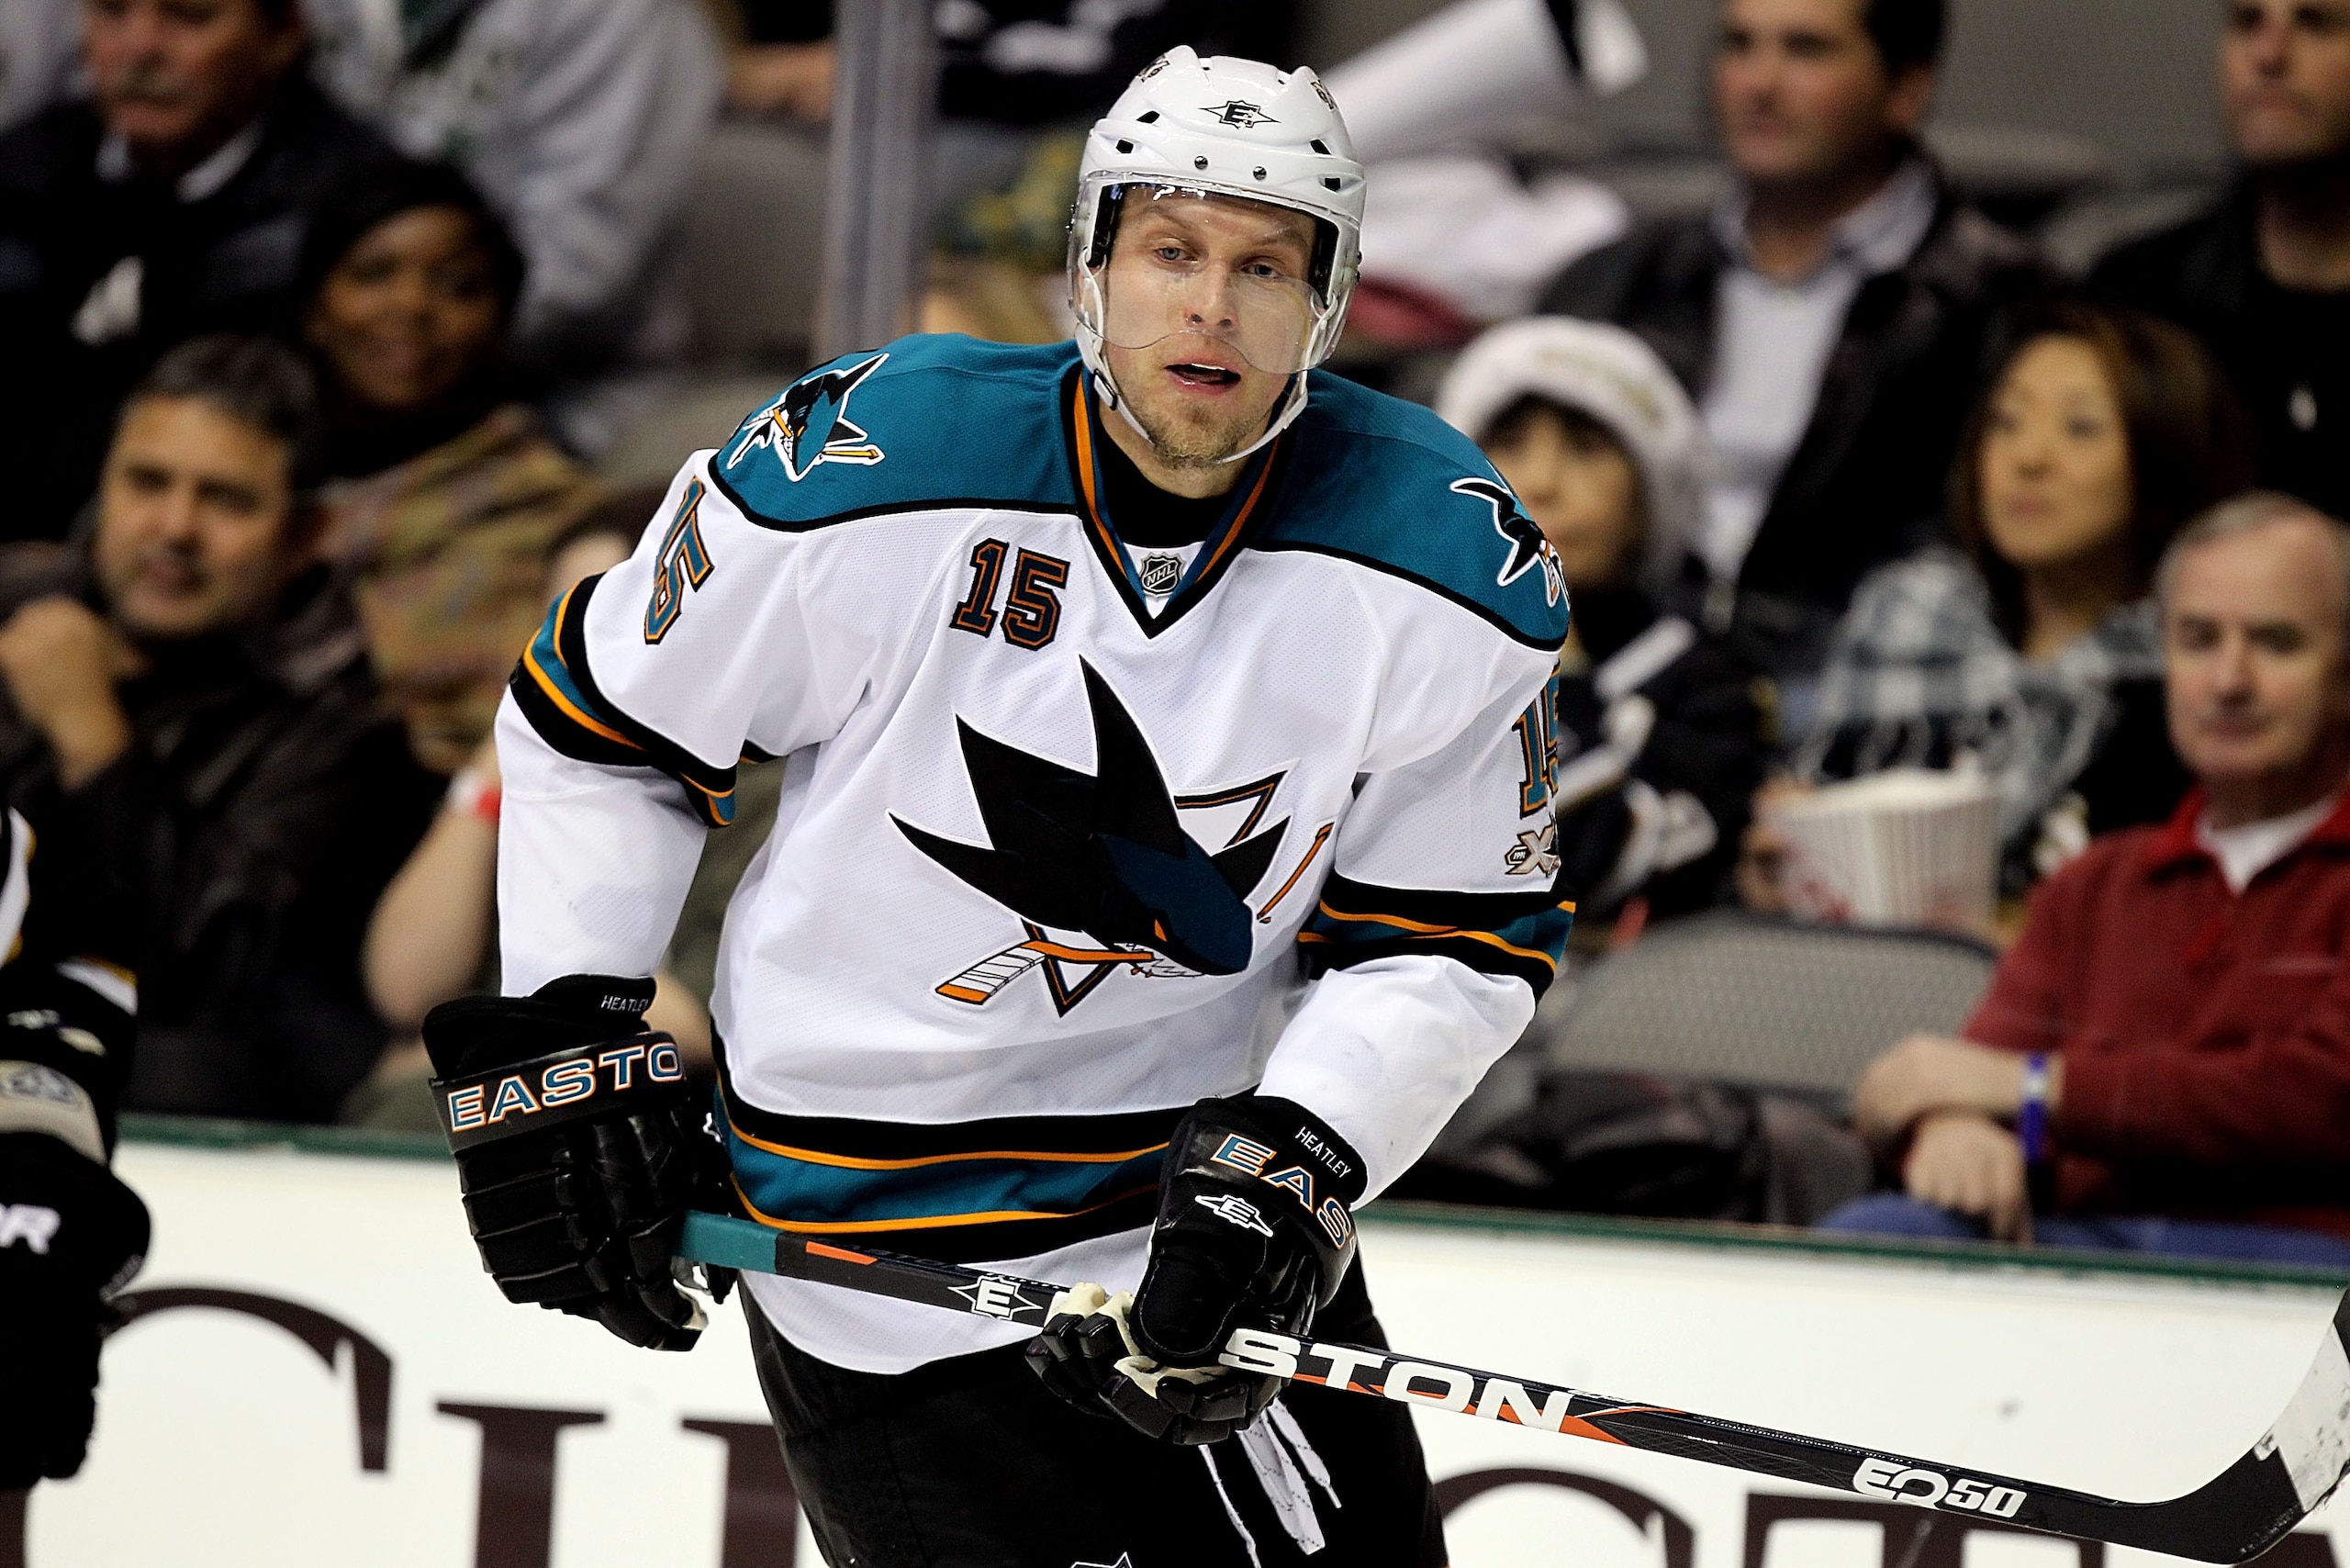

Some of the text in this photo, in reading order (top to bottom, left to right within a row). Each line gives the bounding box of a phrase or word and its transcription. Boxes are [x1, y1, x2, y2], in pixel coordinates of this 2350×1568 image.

[949, 537, 1072, 651] 15
[1147, 564, 1176, 587] NHL
[447, 1042, 683, 1132] EASTO
[1210, 1133, 1357, 1250] EAS
[1294, 1126, 1352, 1179] HEATLEY
[1218, 1327, 1575, 1433] STON
